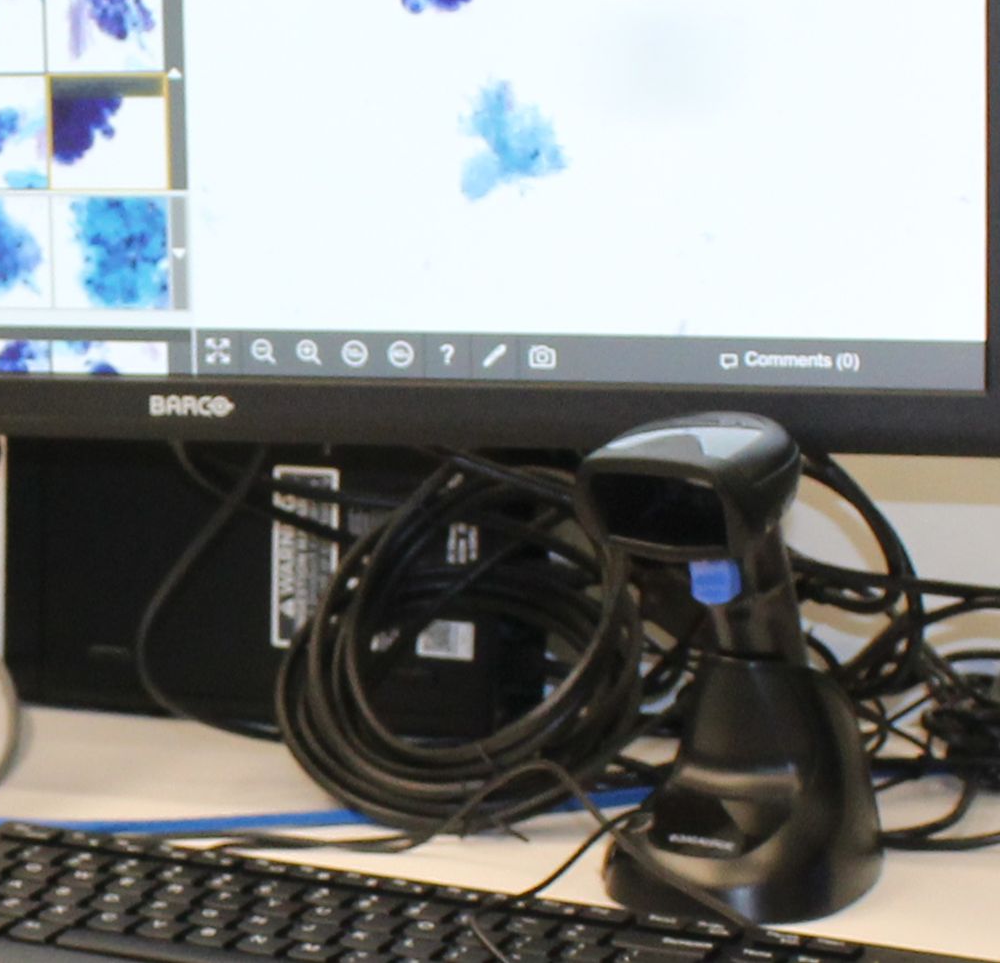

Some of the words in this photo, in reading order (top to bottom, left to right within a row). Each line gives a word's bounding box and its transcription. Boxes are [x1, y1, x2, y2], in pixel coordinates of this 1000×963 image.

[744, 350, 832, 368] Comments
[836, 352, 860, 371] (0)
[149, 394, 236, 417] BARCO
